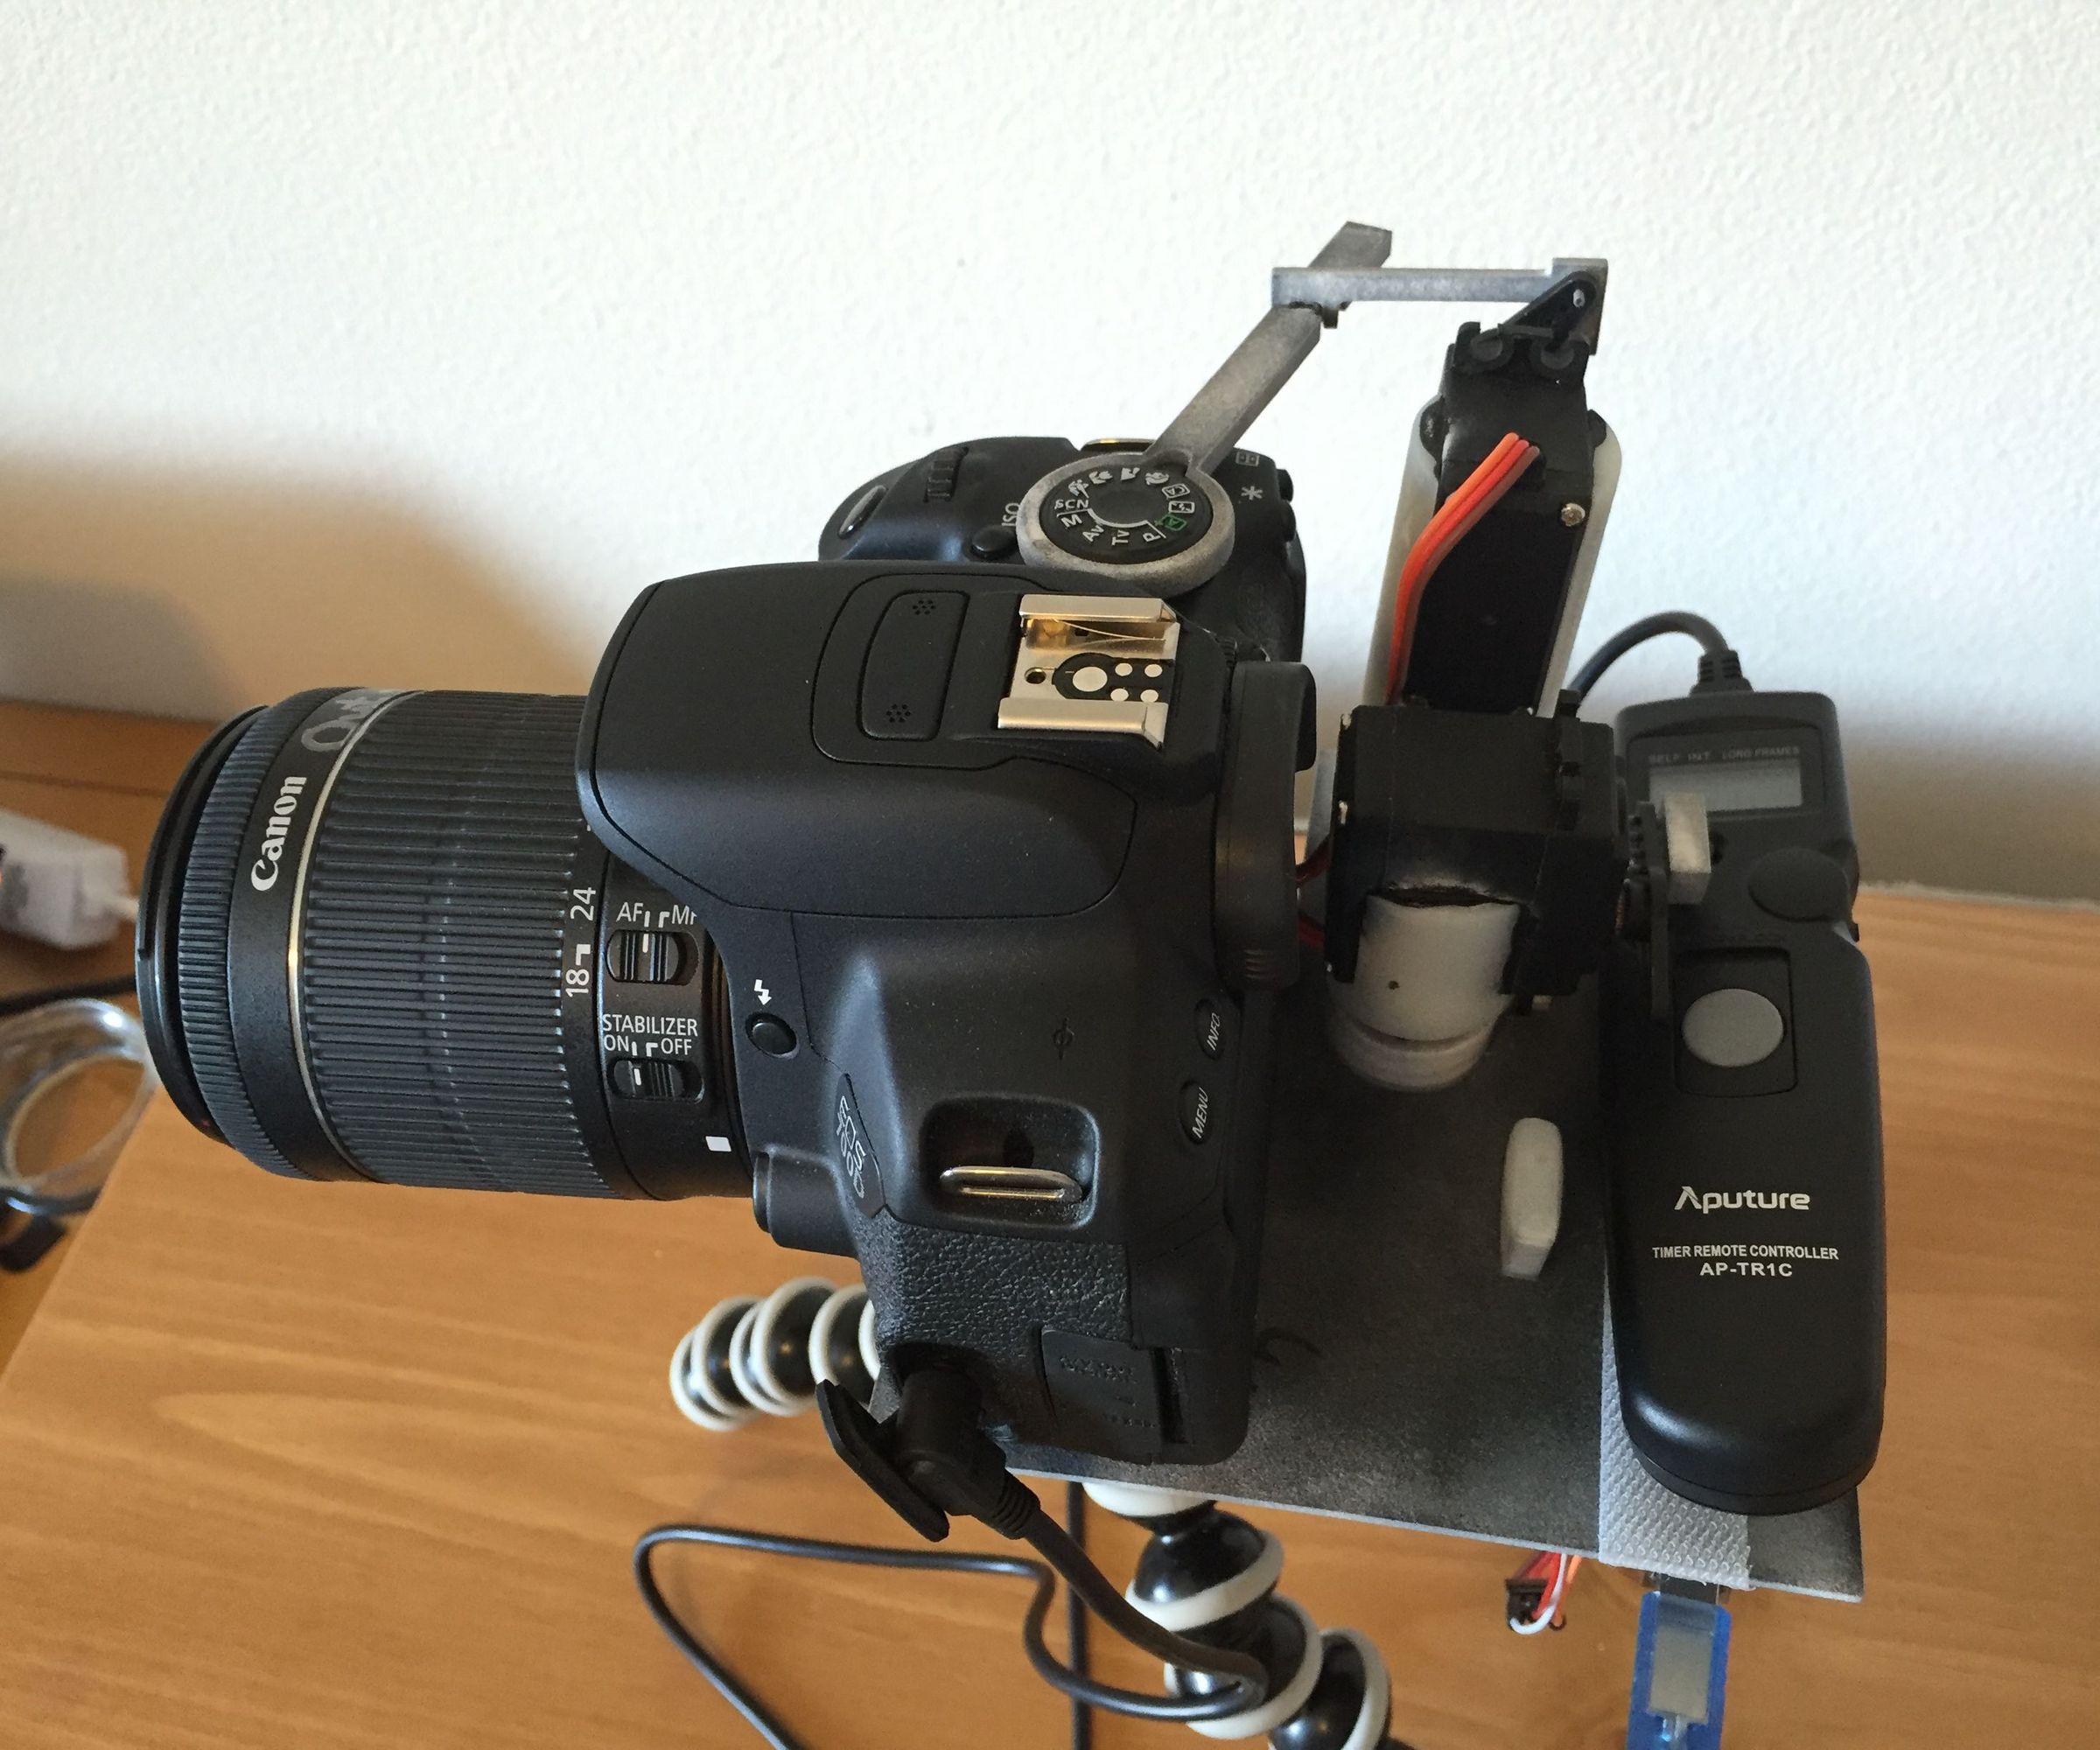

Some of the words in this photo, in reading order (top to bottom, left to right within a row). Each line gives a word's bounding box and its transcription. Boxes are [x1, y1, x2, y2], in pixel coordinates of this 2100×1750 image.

[1001, 502, 1020, 527] ISO
[1054, 499, 1089, 510] SCN
[1060, 514, 1083, 528] M
[1082, 523, 1105, 542] Av
[1111, 529, 1130, 546] Tv
[1142, 532, 1161, 542] P
[250, 776, 307, 891] Canon
[570, 886, 596, 920] 24
[616, 902, 643, 922] AF
[565, 969, 590, 998] 18
[602, 1013, 698, 1037] STABILIZER
[1207, 1012, 1221, 1051] INFO
[603, 1034, 629, 1053] ON
[661, 1038, 693, 1056] OFF
[1192, 1087, 1208, 1138] MENU
[839, 1096, 867, 1172] EOS
[1674, 1186, 1810, 1214] Aputure
[1652, 1246, 1691, 1259] TIMER
[1693, 1244, 1747, 1257] REMOTE
[1749, 1244, 1839, 1260] CONTROLLER
[1699, 1262, 1793, 1278] AP-TR1C
